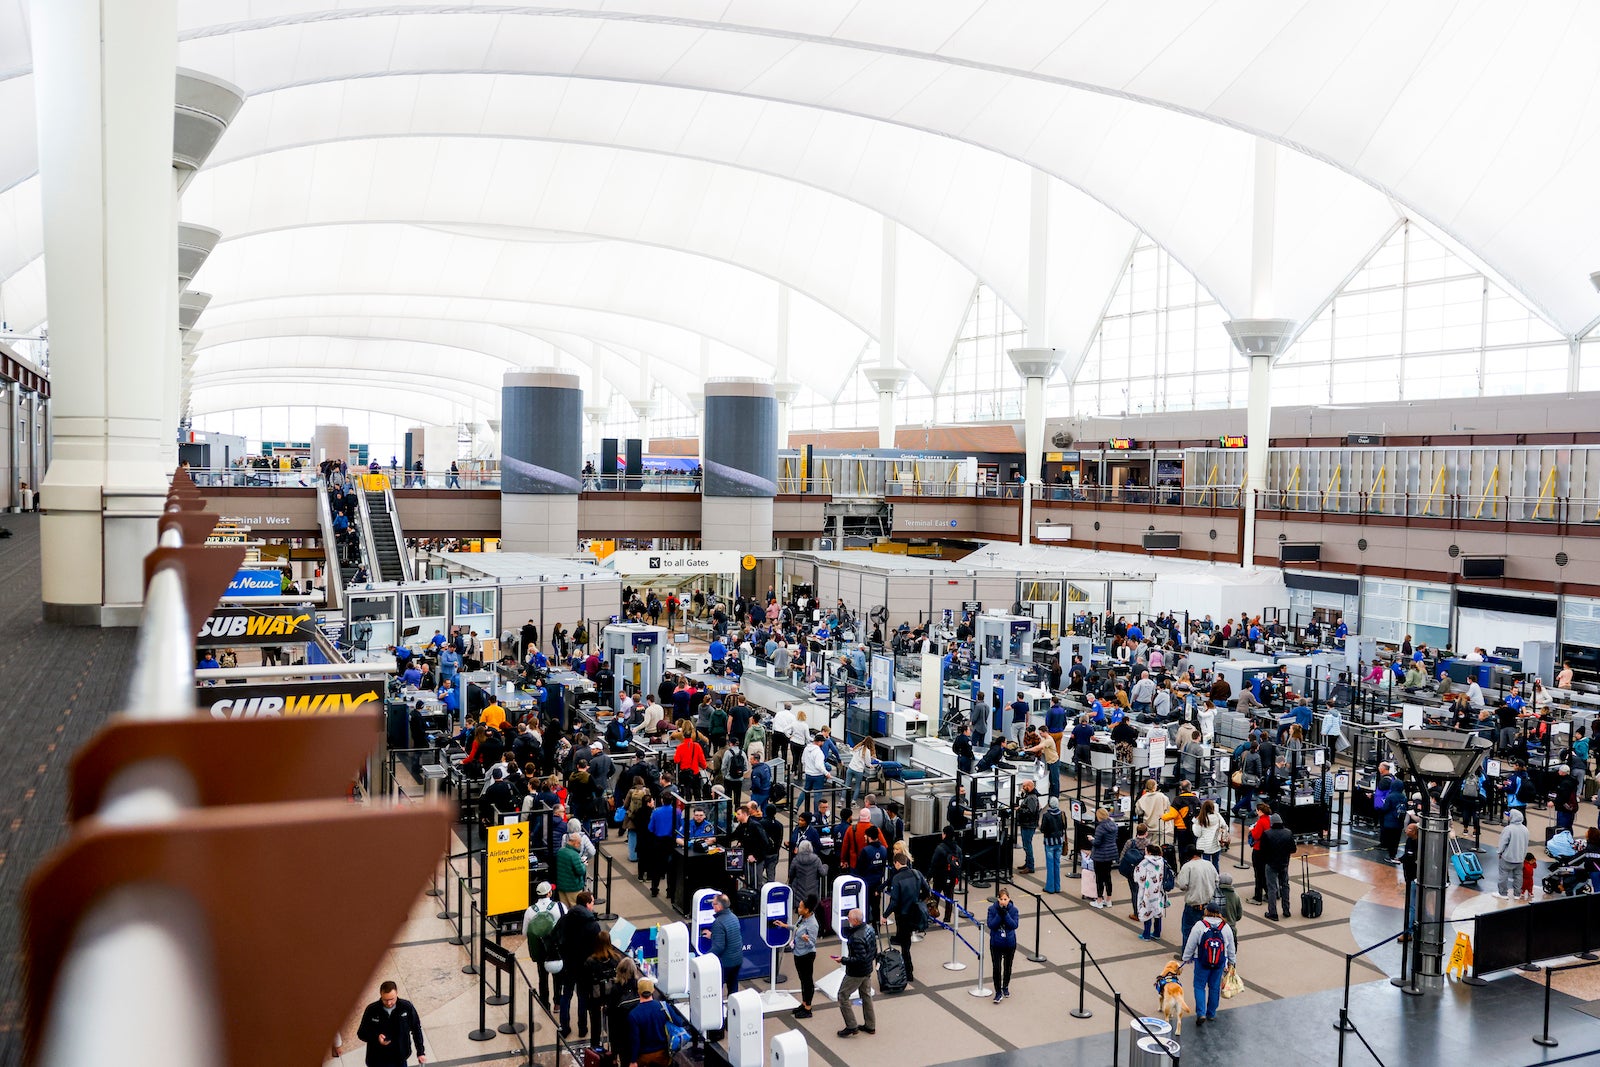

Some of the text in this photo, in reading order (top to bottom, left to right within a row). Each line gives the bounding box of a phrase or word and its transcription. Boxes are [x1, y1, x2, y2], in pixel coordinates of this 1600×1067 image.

[266, 516, 290, 524] West
[904, 519, 950, 527] Terminal East
[675, 559, 685, 567] all
[686, 559, 709, 567] Gates
[239, 577, 279, 589] News
[198, 613, 311, 637] SUBWAY
[489, 847, 526, 858] Airline Crew
[497, 855, 526, 864] Members
